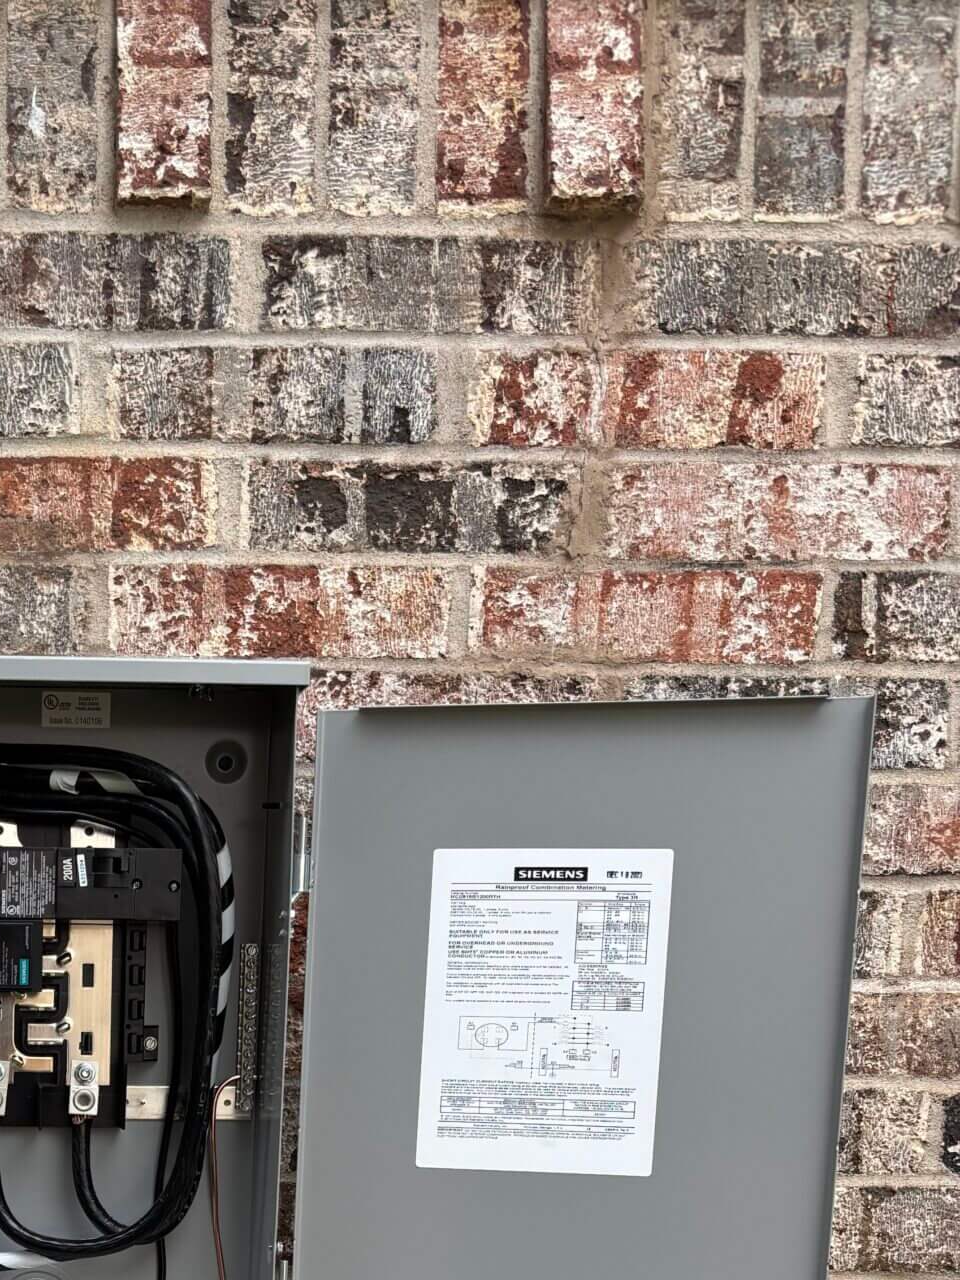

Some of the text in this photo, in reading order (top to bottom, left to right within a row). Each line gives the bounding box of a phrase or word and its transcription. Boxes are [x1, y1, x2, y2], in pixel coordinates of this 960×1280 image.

[62, 858, 73, 881] 200A
[518, 870, 584, 879] SIEMENS
[576, 884, 607, 892] Metering
